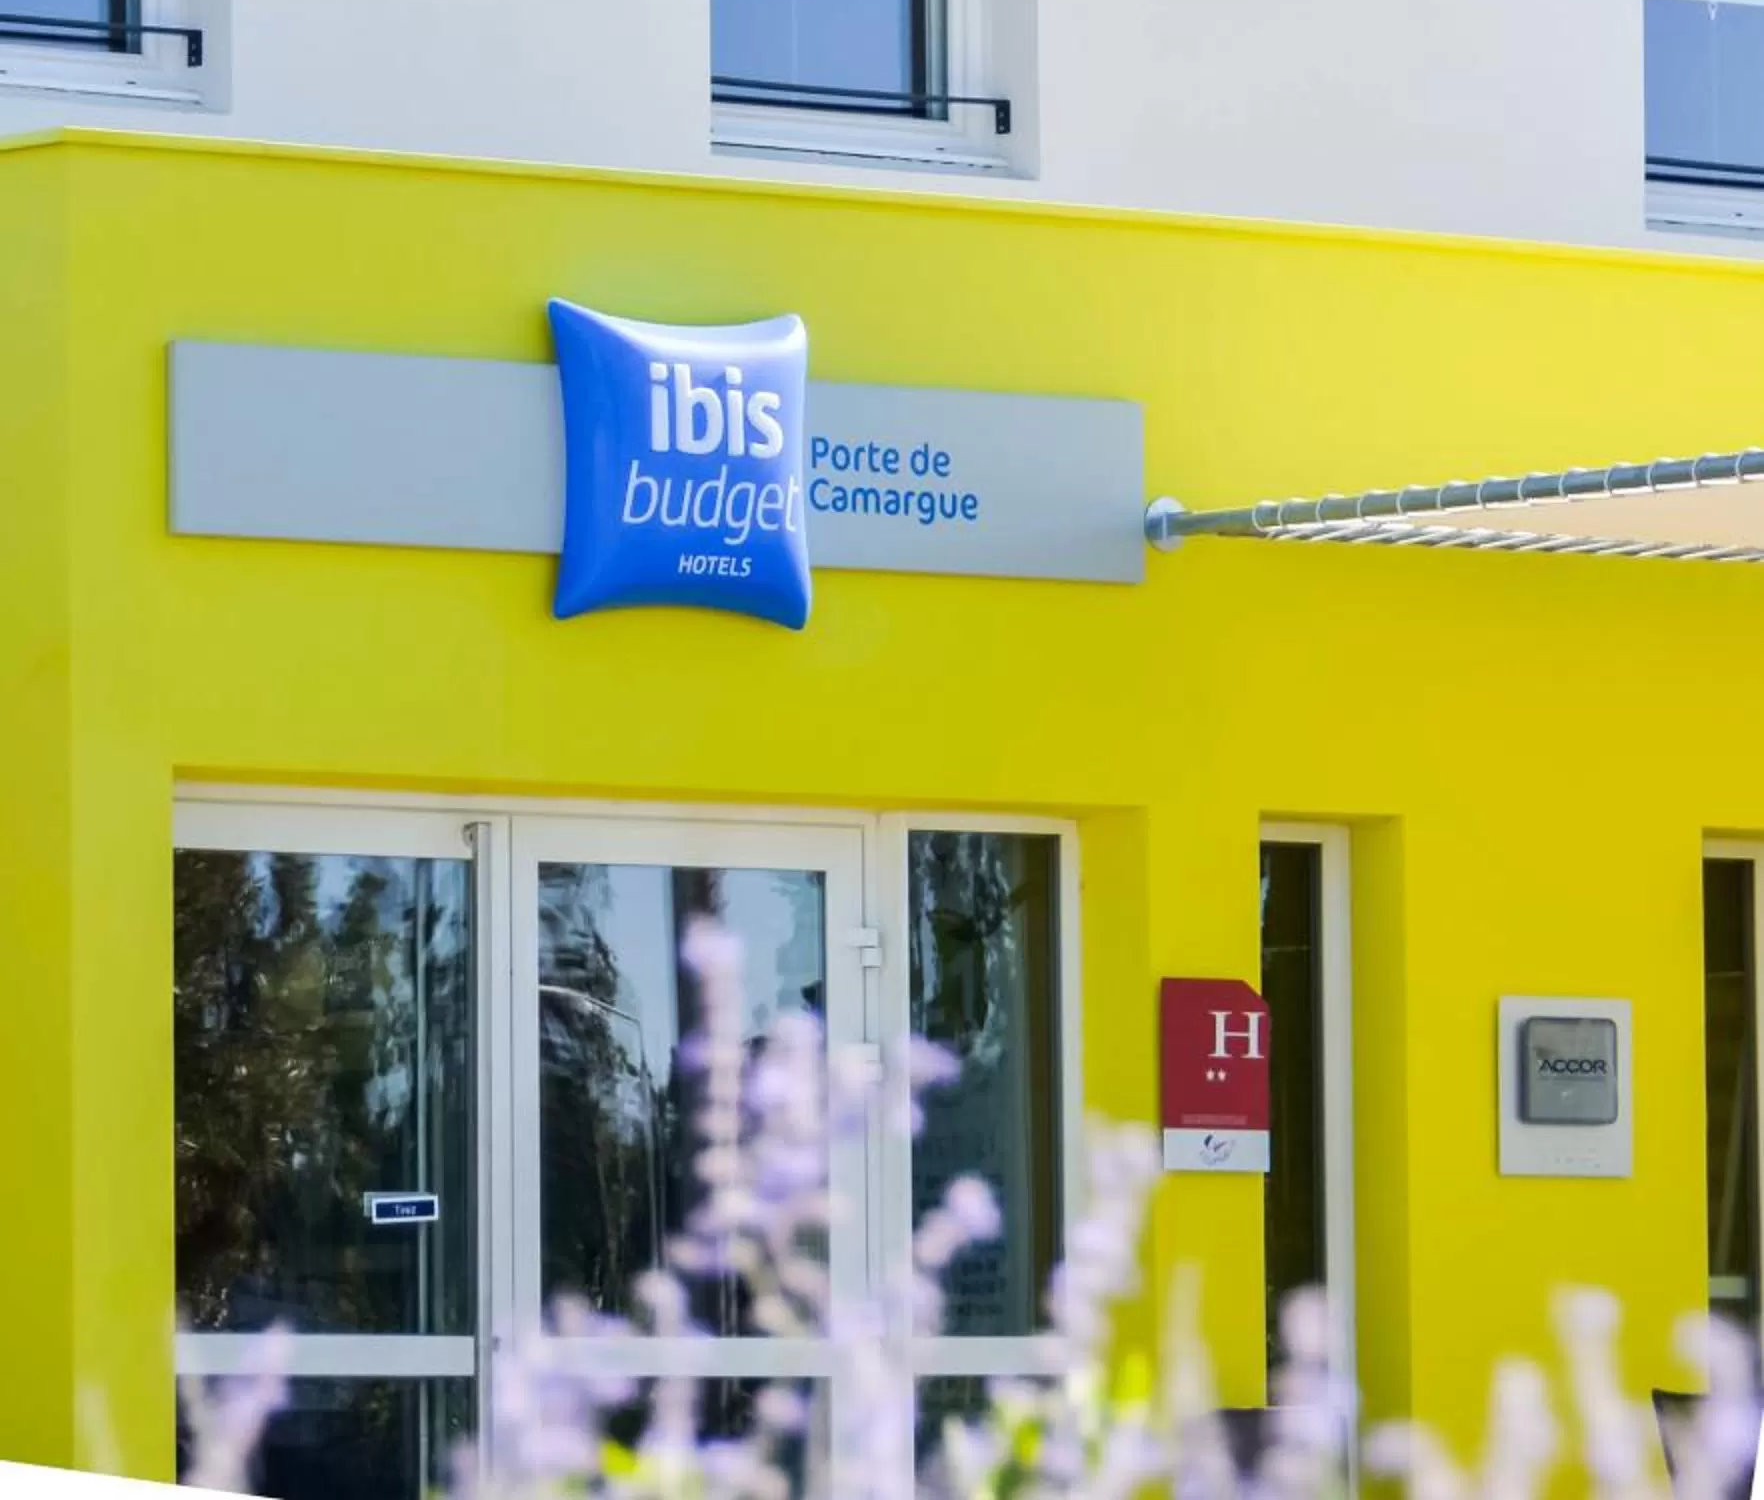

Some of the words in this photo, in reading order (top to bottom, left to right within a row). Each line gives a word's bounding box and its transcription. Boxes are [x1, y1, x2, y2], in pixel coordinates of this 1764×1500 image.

[649, 362, 785, 459] ibis
[810, 436, 900, 476] Porte
[909, 442, 951, 478] de
[622, 460, 800, 545] budget
[809, 477, 979, 525] Camargue
[678, 554, 752, 578] HOTELS
[1207, 1010, 1266, 1059] H
[1538, 1058, 1608, 1075] ACCOR
